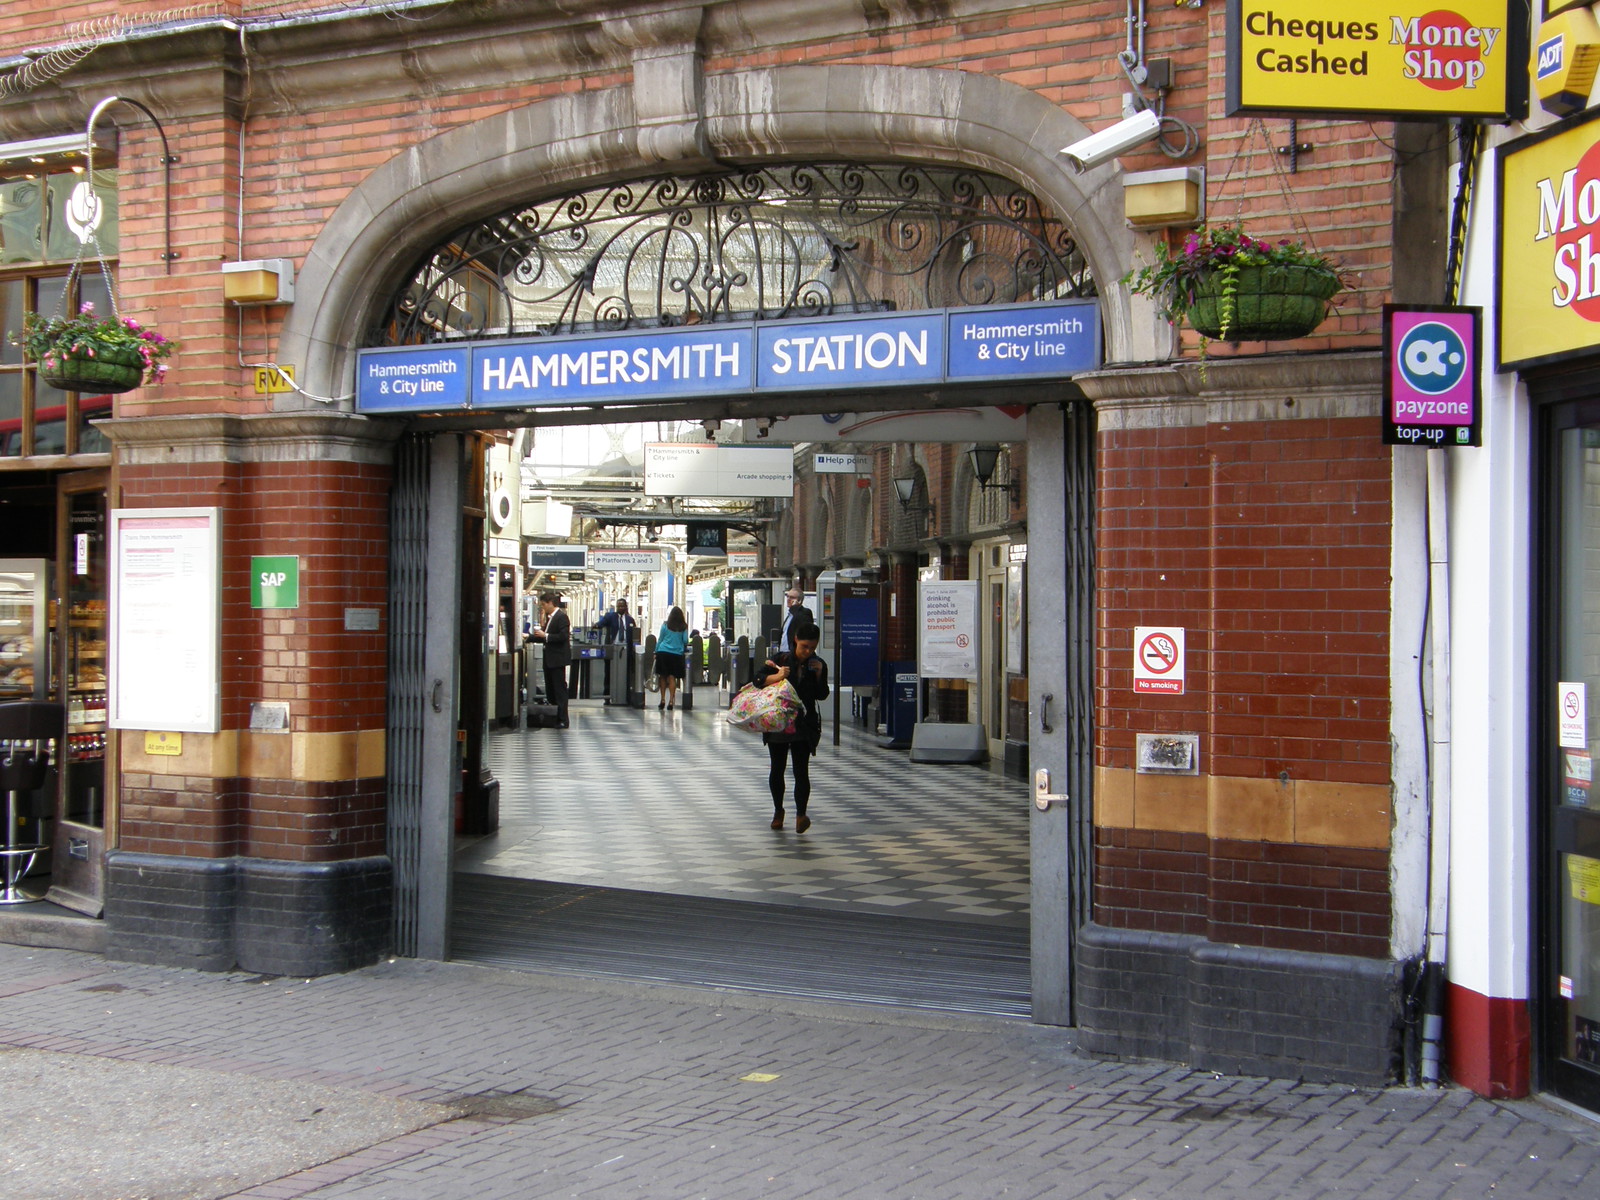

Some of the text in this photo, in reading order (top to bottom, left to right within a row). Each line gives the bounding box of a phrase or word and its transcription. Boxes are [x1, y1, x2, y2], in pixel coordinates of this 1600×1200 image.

[1246, 11, 1379, 45] Cheques
[1388, 15, 1501, 57] Money
[1256, 47, 1369, 76] Cashed
[1537, 41, 1563, 72] ADT
[1402, 50, 1485, 89] Shop
[963, 317, 1084, 341] Hammersmith
[482, 329, 928, 391] HAMMERSMITH STATION
[978, 339, 1066, 362] & City line
[368, 359, 457, 378] Hammersmith
[379, 377, 445, 396] & City line
[1395, 400, 1469, 418] payzone
[1396, 425, 1444, 443] top-up
[825, 456, 867, 465] Help point
[260, 572, 286, 586] SAP
[1151, 682, 1178, 690] smoking
